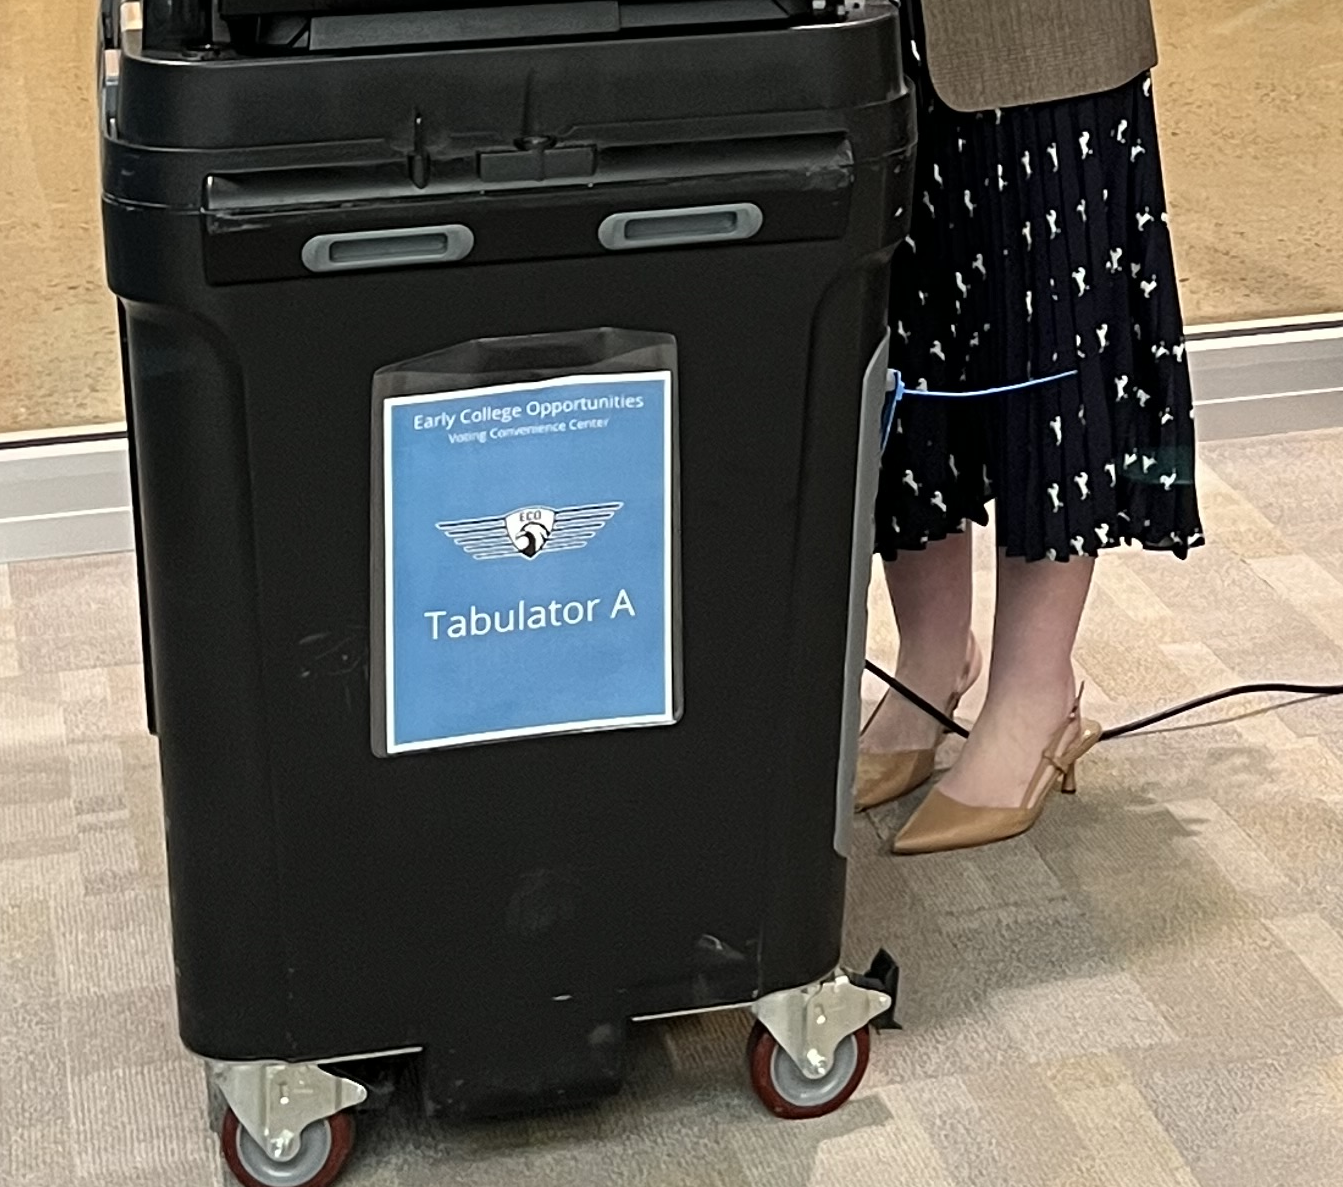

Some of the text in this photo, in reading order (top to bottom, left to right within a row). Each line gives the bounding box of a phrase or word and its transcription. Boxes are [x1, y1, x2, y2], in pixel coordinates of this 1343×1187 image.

[413, 395, 644, 431] Early College Opportunities
[448, 417, 609, 444] Voting Convenience Center
[519, 510, 542, 522] ECO
[423, 588, 636, 640] Tabulator A
